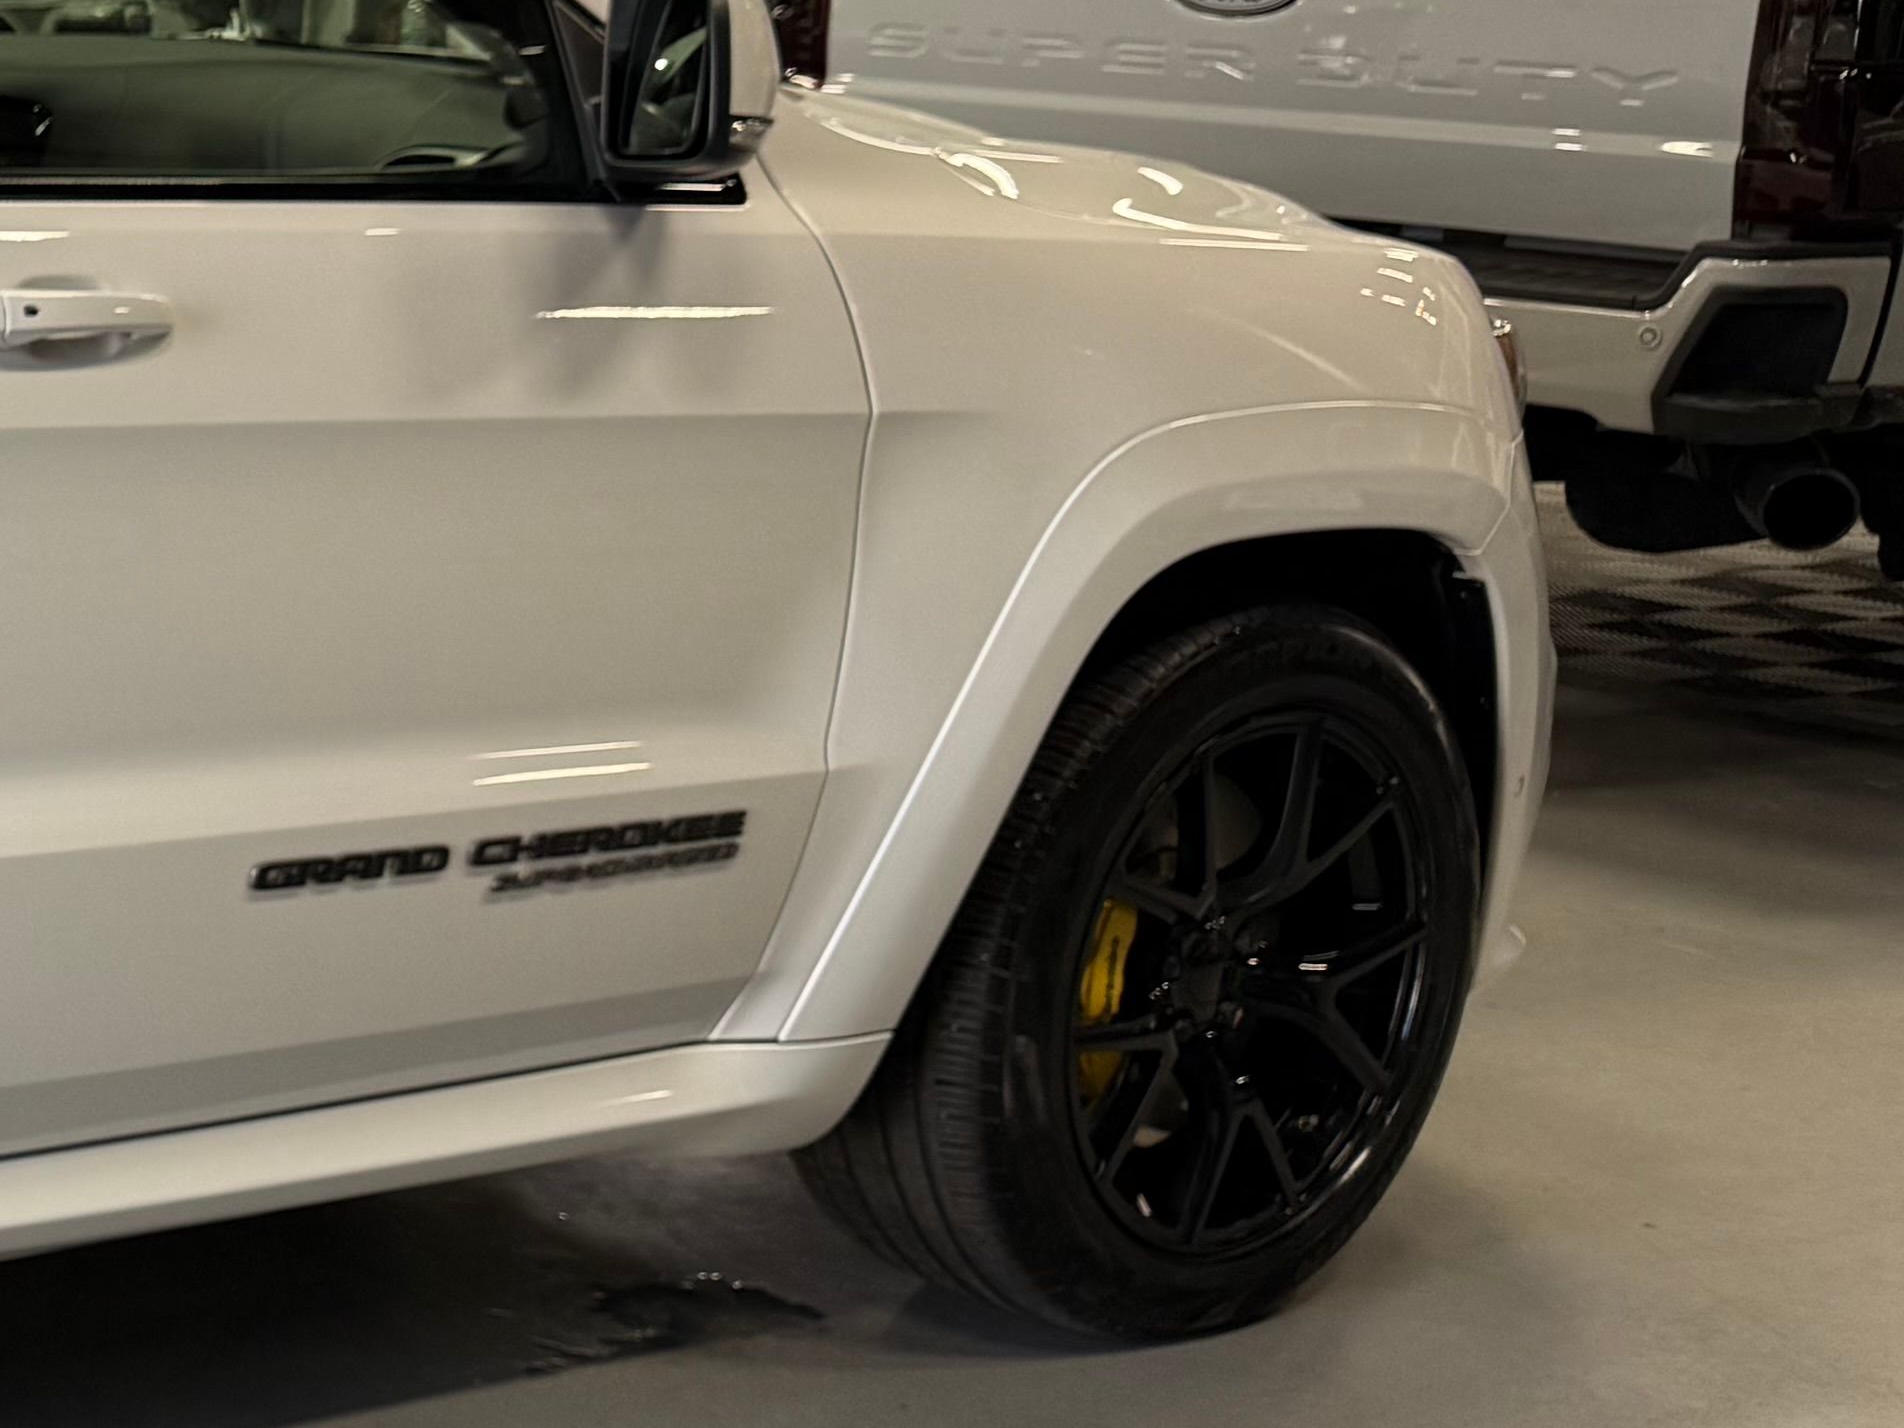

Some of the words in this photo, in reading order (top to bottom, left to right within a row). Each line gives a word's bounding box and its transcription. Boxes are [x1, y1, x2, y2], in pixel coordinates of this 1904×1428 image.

[868, 22, 1255, 81] SUPER
[1295, 48, 1680, 107] DUTY
[252, 845, 450, 891] GRAND
[469, 810, 748, 867] CHEROKEE
